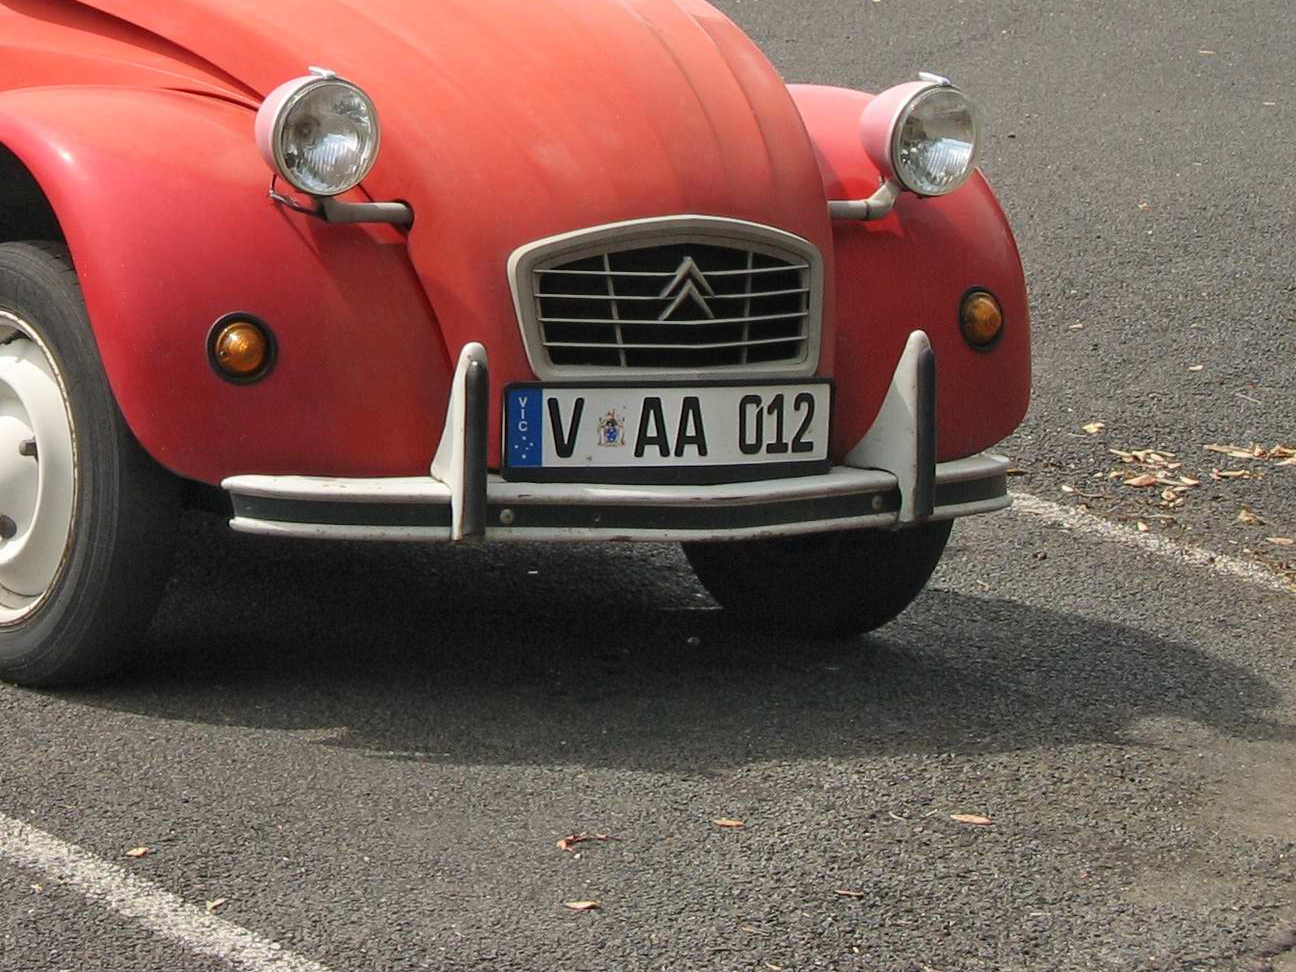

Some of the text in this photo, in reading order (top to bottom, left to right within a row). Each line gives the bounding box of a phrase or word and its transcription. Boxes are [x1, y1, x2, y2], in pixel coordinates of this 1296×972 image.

[518, 396, 528, 432] VIC
[547, 392, 815, 458] V AA 012
